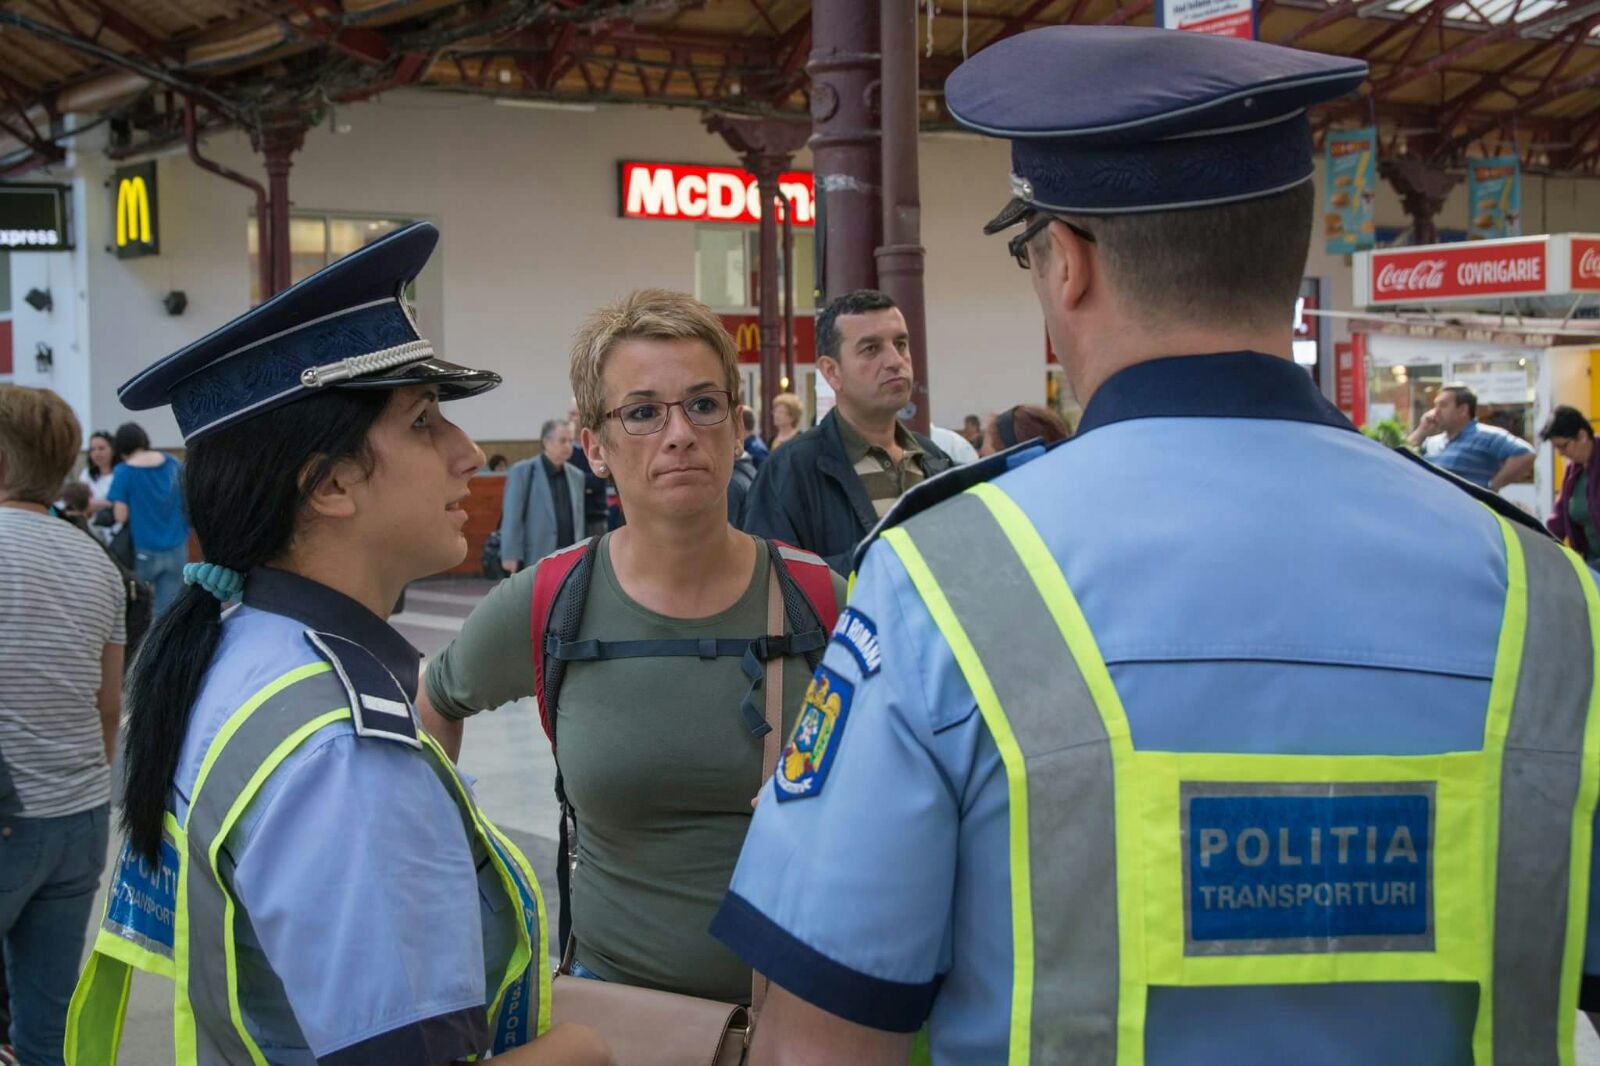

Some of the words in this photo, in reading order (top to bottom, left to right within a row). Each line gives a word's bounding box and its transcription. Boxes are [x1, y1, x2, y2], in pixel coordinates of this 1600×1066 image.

[1456, 256, 1541, 287] COVRIGARIE
[1199, 825, 1419, 868] POLITIA
[1199, 880, 1417, 910] TRANSPORTURI
